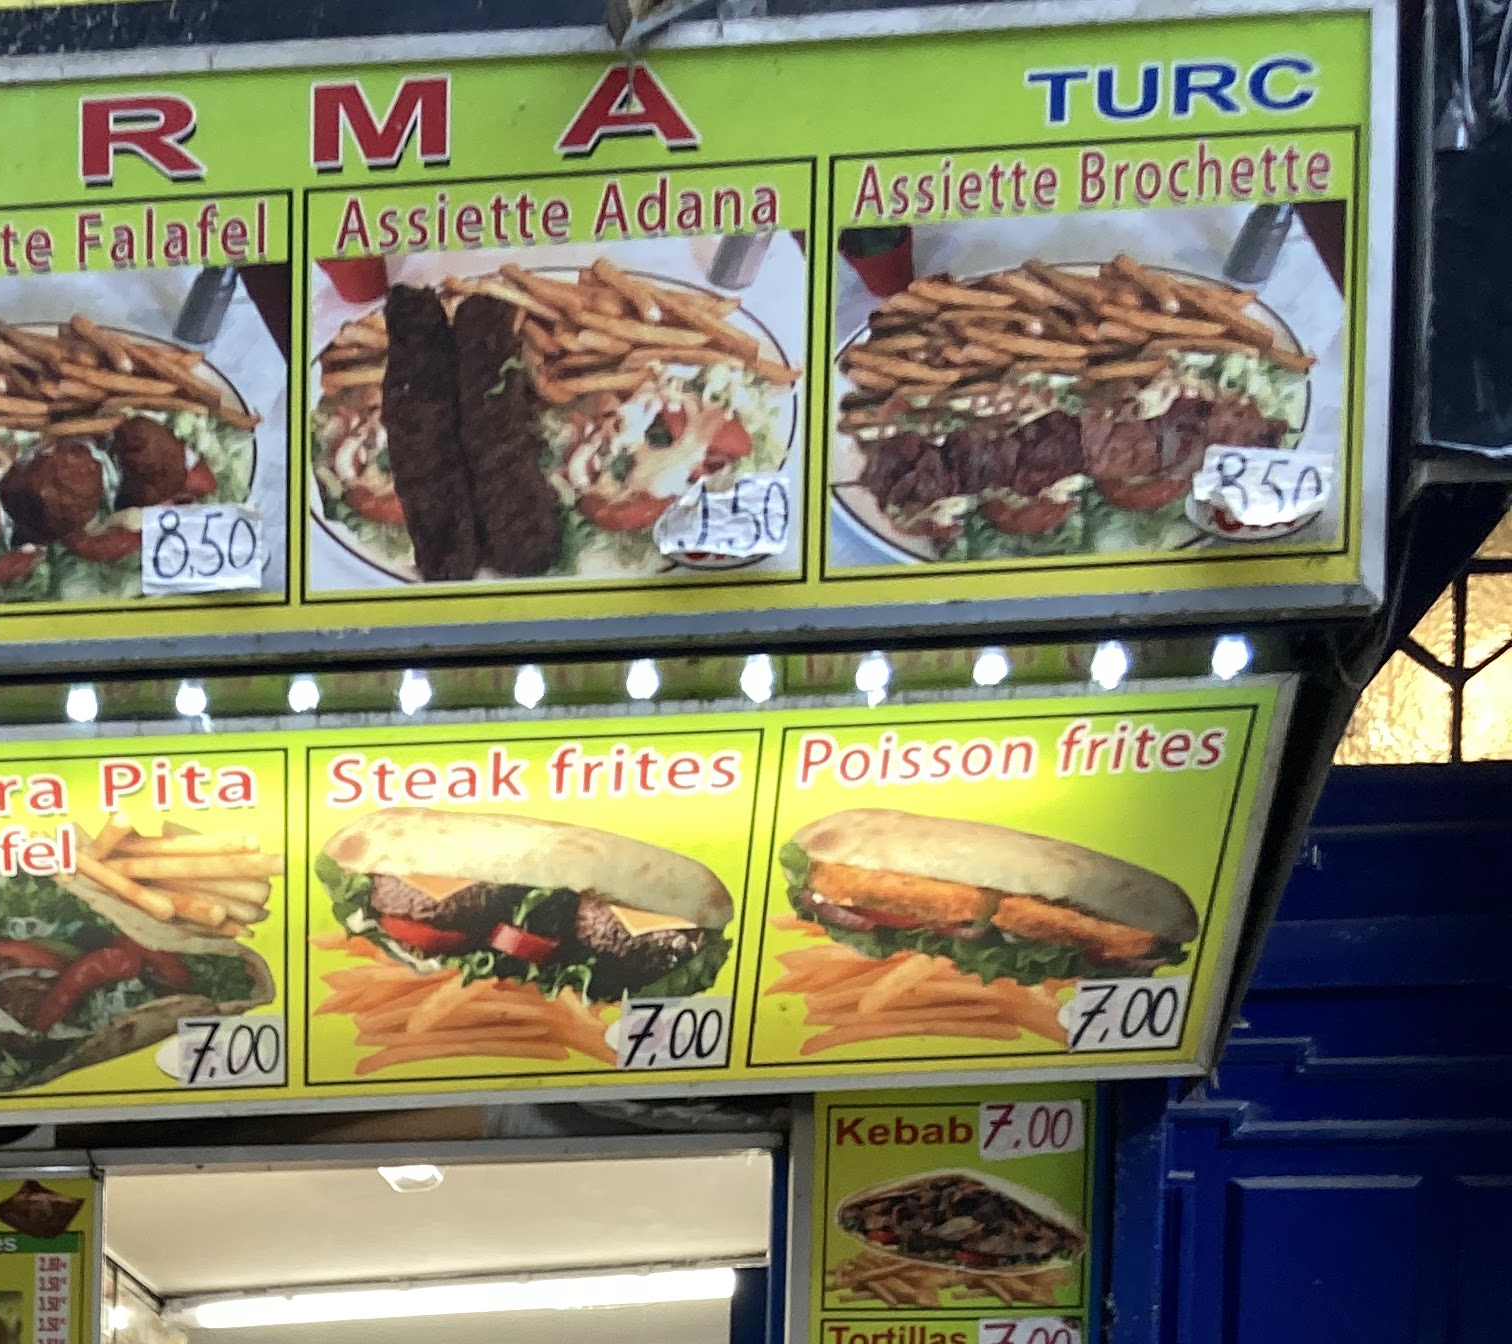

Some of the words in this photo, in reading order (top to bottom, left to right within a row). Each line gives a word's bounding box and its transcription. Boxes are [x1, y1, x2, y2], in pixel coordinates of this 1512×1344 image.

[1026, 57, 1317, 125] TURC
[337, 190, 570, 252] Assiette
[594, 173, 779, 241] Adana
[853, 161, 1057, 219] Assiette
[1079, 141, 1331, 204] Brochette
[77, 201, 267, 266] Falafel
[100, 759, 258, 812] Pita
[330, 749, 527, 805] Steak
[552, 745, 740, 798] frites
[797, 733, 1038, 787] Poisson
[1059, 722, 1227, 779] frites
[622, 1001, 724, 1068] 7.00
[1068, 983, 1180, 1050] 7.00
[182, 1020, 283, 1084] 7.00
[834, 1116, 974, 1146] Kebab
[982, 1103, 1074, 1150] 7.00
